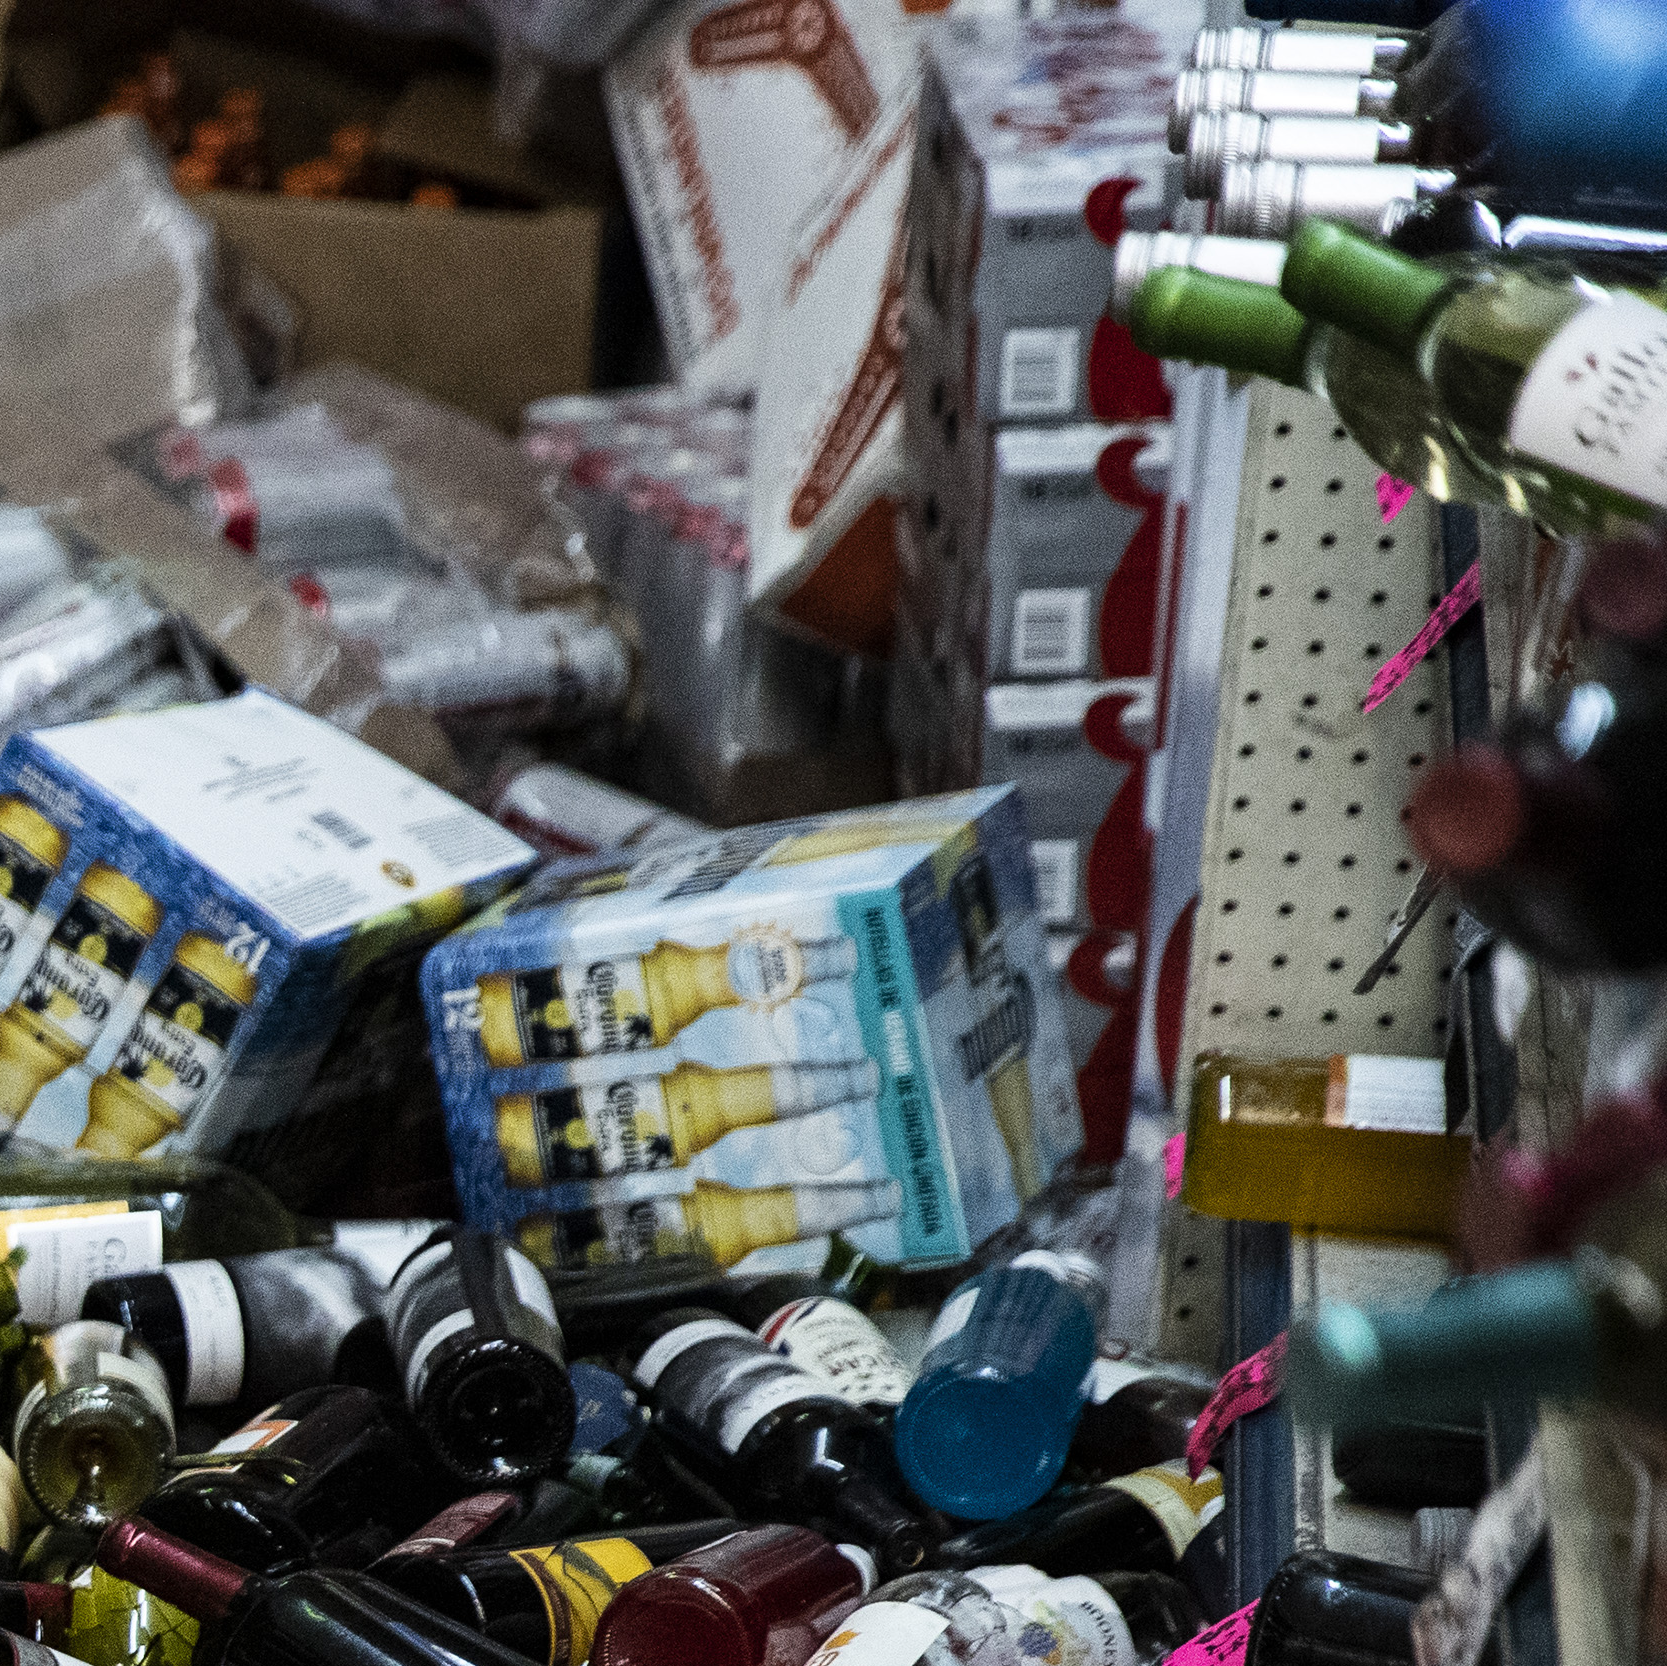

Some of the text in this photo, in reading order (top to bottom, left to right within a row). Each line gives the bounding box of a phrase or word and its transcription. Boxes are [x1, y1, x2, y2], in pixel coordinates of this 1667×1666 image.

[225, 922, 271, 975] 12
[36, 956, 111, 1022] Corona
[442, 985, 484, 1031] 12
[587, 961, 618, 1054] Corona
[131, 1025, 207, 1089] Corona
[608, 1082, 641, 1171] Corona
